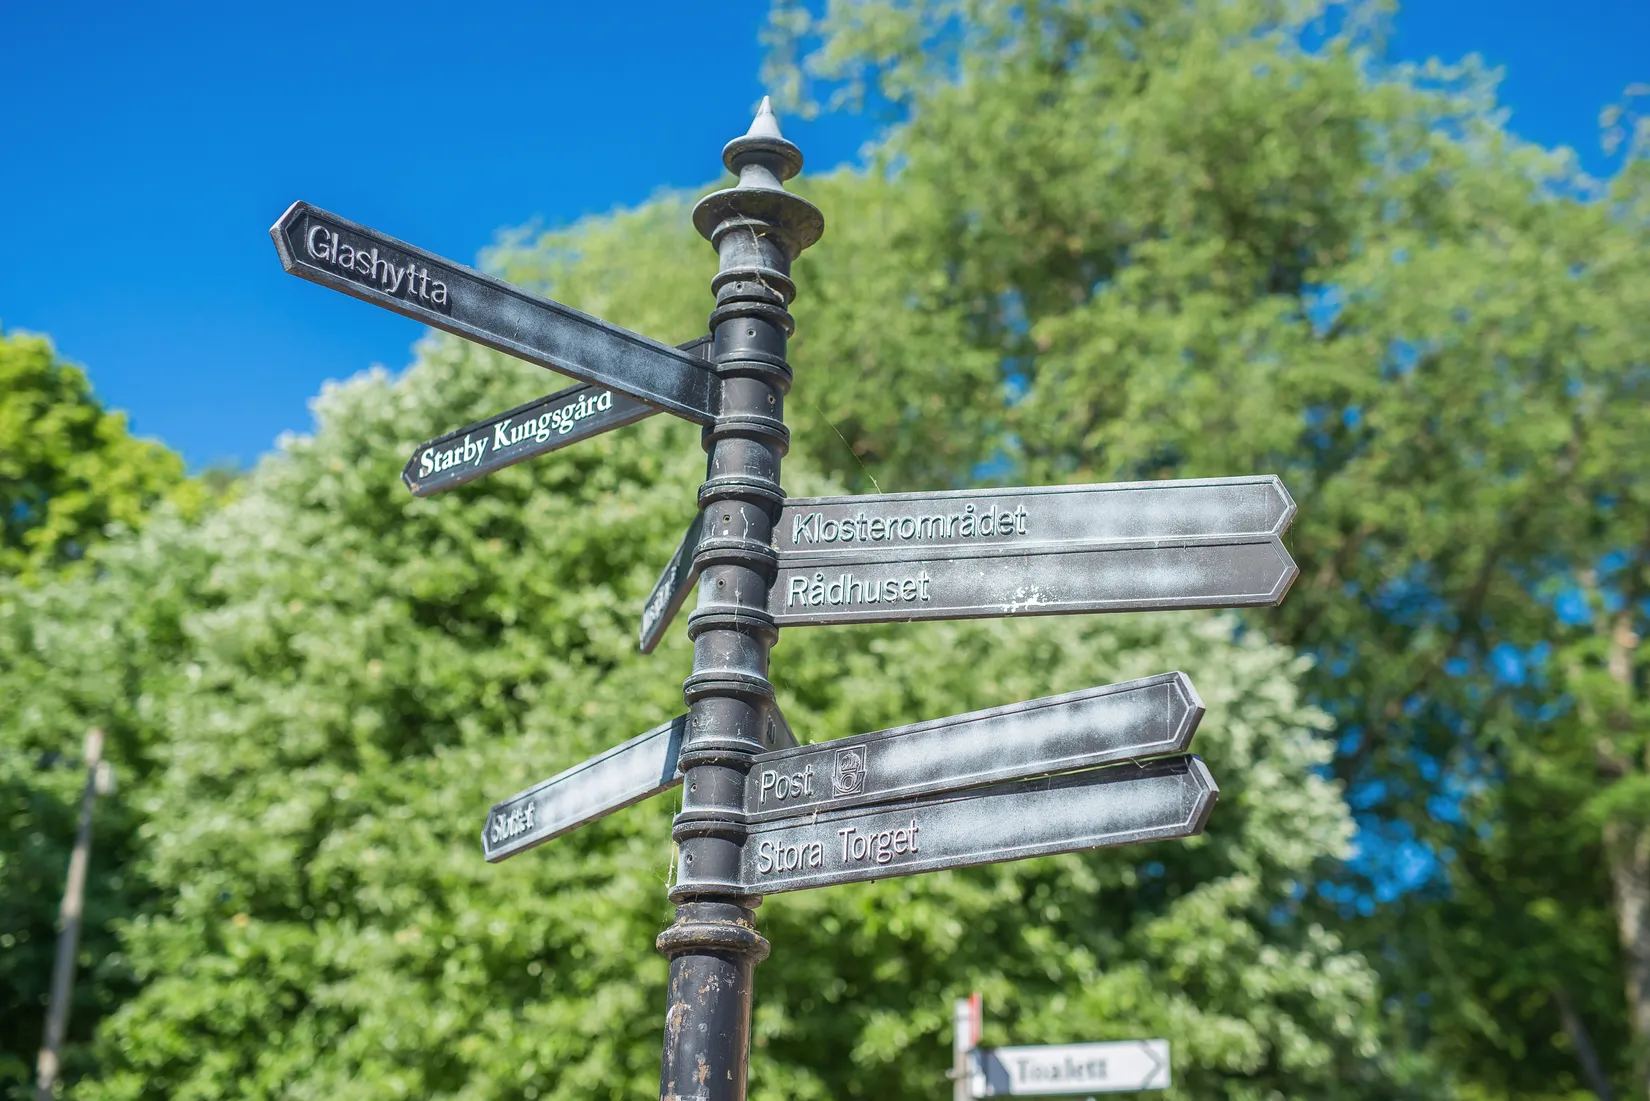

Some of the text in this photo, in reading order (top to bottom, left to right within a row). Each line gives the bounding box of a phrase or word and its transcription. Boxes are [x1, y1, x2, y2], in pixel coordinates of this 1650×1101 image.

[307, 224, 448, 306] Glashytta
[419, 390, 613, 479] Starby Kungsgård
[792, 503, 1027, 544] Klosterområdet
[787, 571, 930, 607] Rådhuset
[760, 763, 813, 804] Post
[757, 819, 919, 874] Stora Torget
